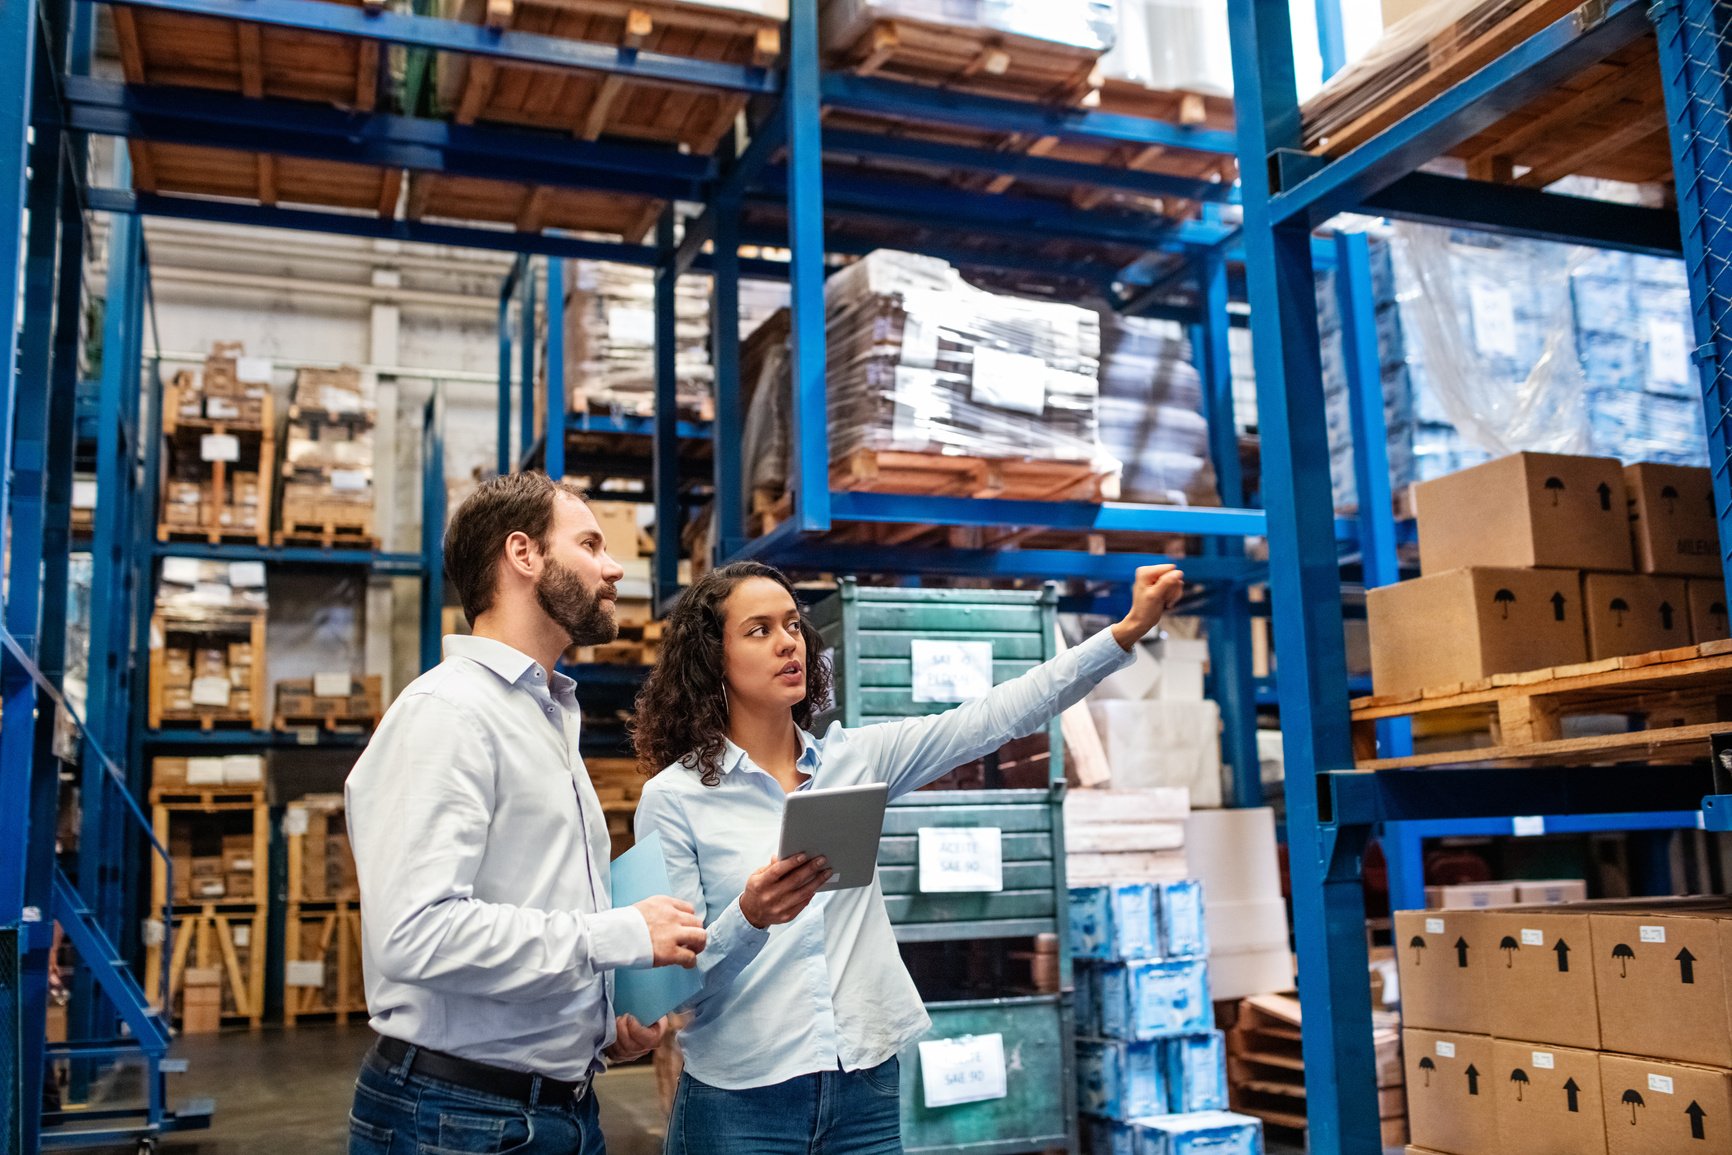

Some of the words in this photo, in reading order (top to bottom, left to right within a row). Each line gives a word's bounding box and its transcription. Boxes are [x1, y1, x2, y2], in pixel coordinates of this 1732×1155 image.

[940, 861, 960, 872] SAE
[944, 1071, 964, 1085] SAE
[968, 1069, 985, 1083] 90
